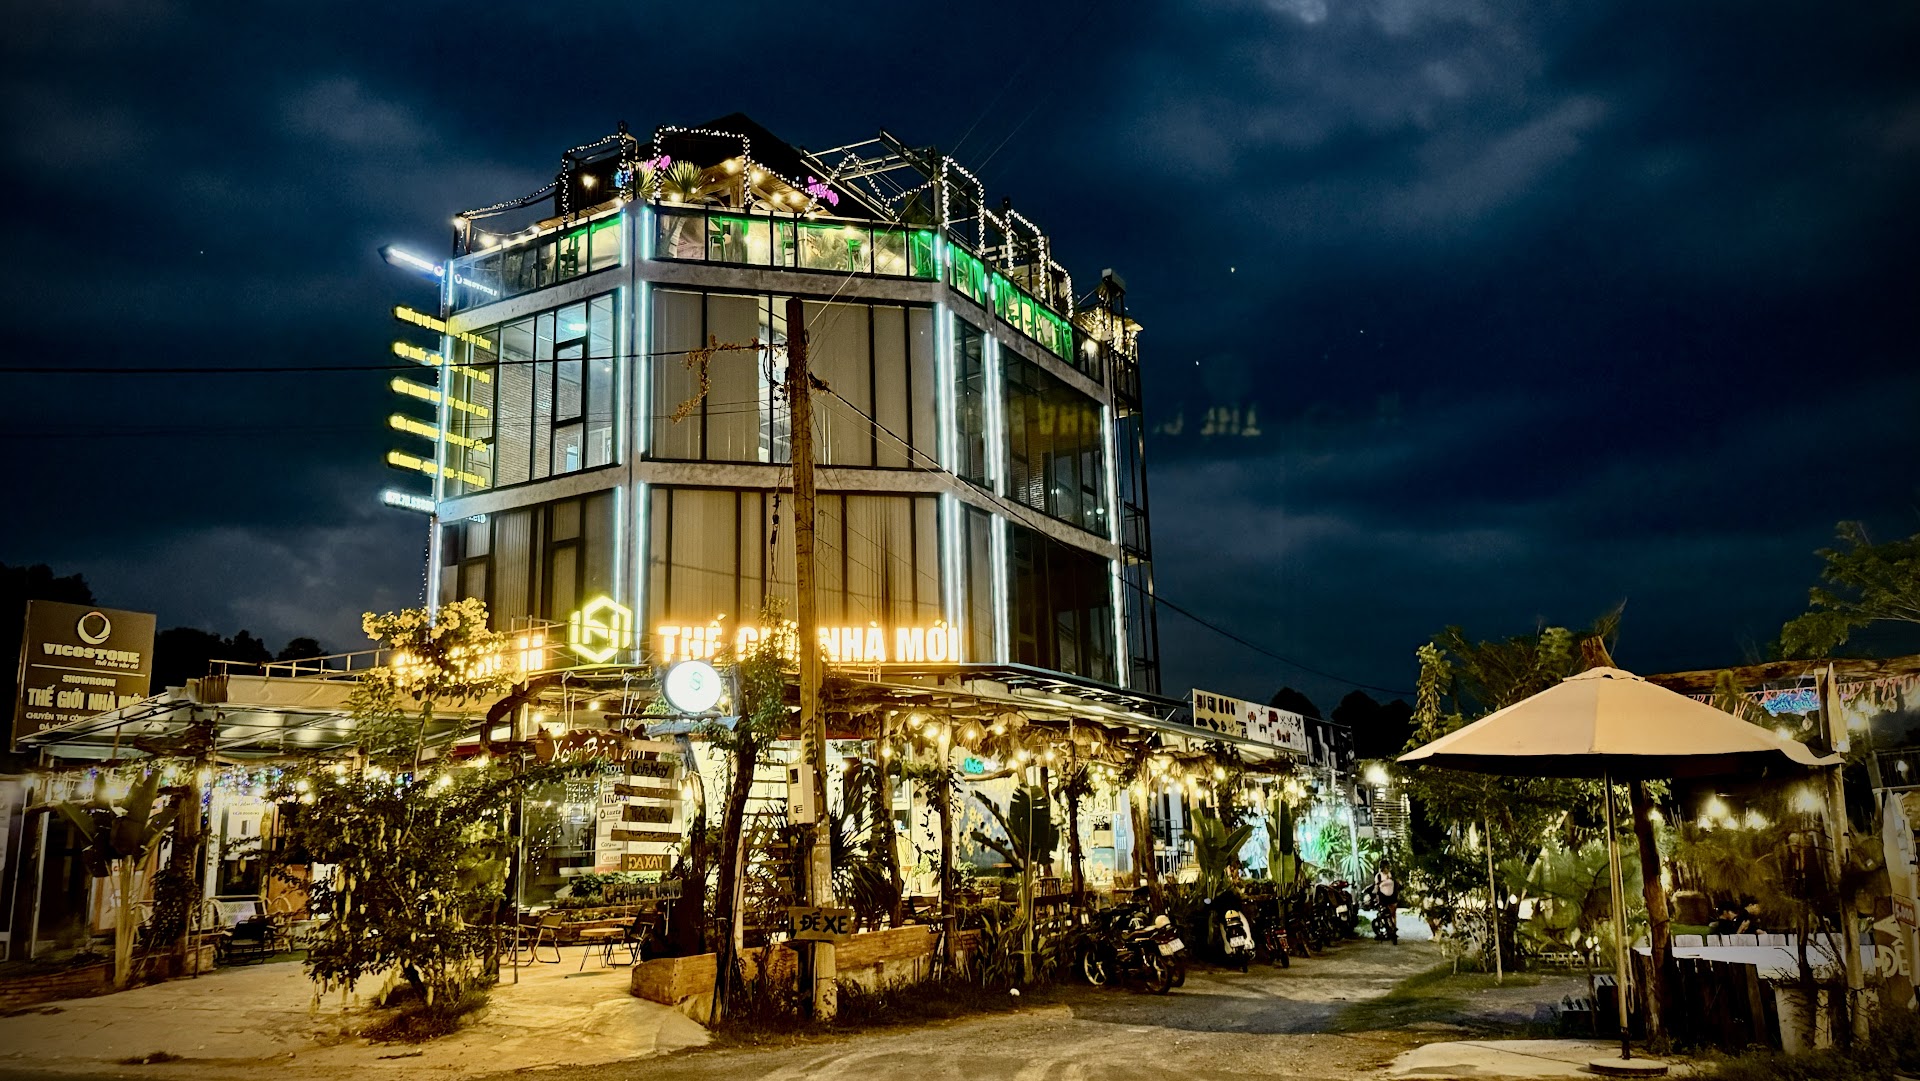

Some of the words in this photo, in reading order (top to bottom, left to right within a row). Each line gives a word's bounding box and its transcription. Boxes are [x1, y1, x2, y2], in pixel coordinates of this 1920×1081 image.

[657, 613, 727, 662] THẾ
[818, 621, 886, 661] NHÀ
[897, 619, 957, 661] MỚI
[43, 643, 140, 663] VICOSTONE
[62, 675, 116, 687] SHOWROOM
[28, 685, 56, 707] THẾ
[57, 688, 85, 709] GIỚI
[88, 691, 116, 711] NHÀ
[26, 712, 54, 721] CHUYÊN
[823, 915, 848, 935] XE
